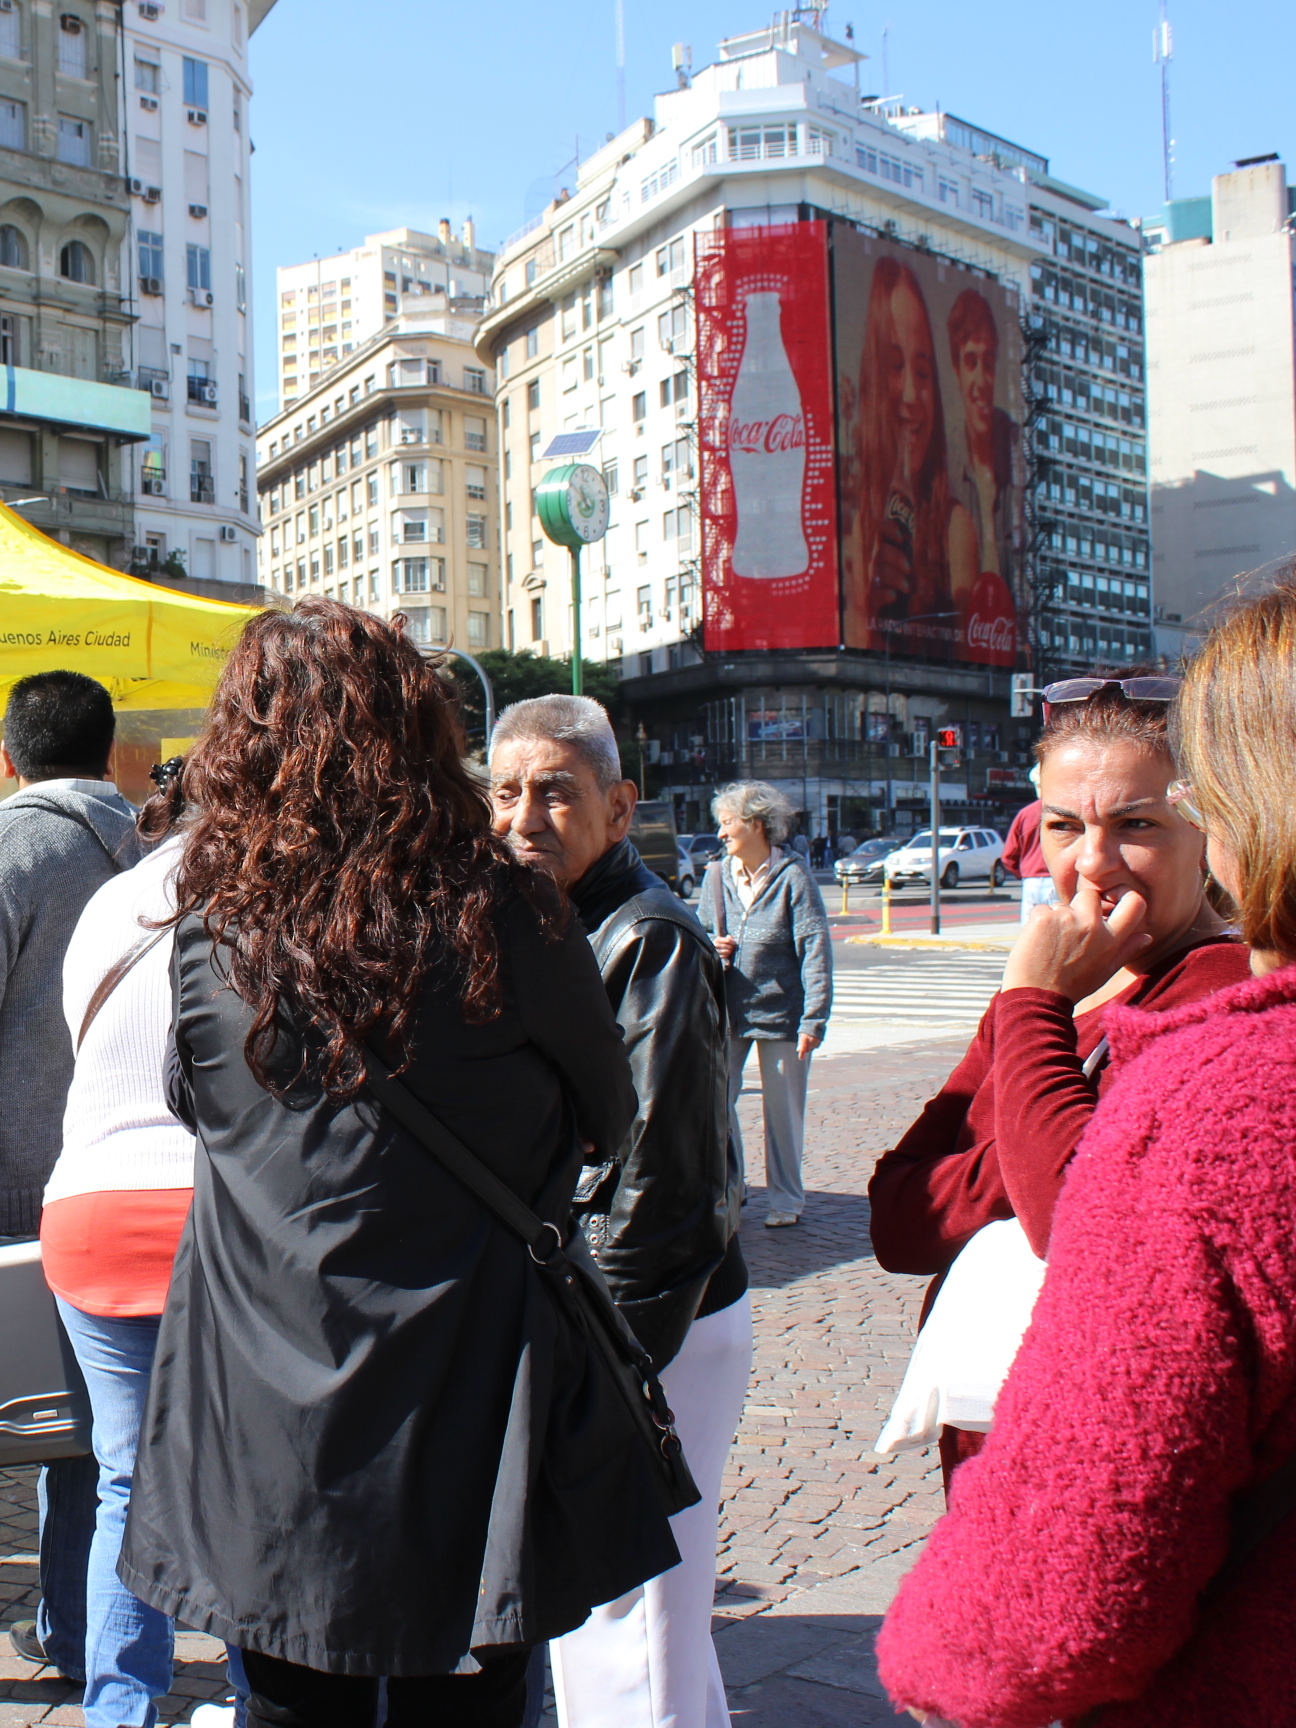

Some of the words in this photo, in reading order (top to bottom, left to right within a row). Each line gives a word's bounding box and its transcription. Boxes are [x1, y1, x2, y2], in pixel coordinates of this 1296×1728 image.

[584, 525, 589, 539] 6
[47, 630, 80, 647] Aires
[84, 631, 131, 648] Ciudad
